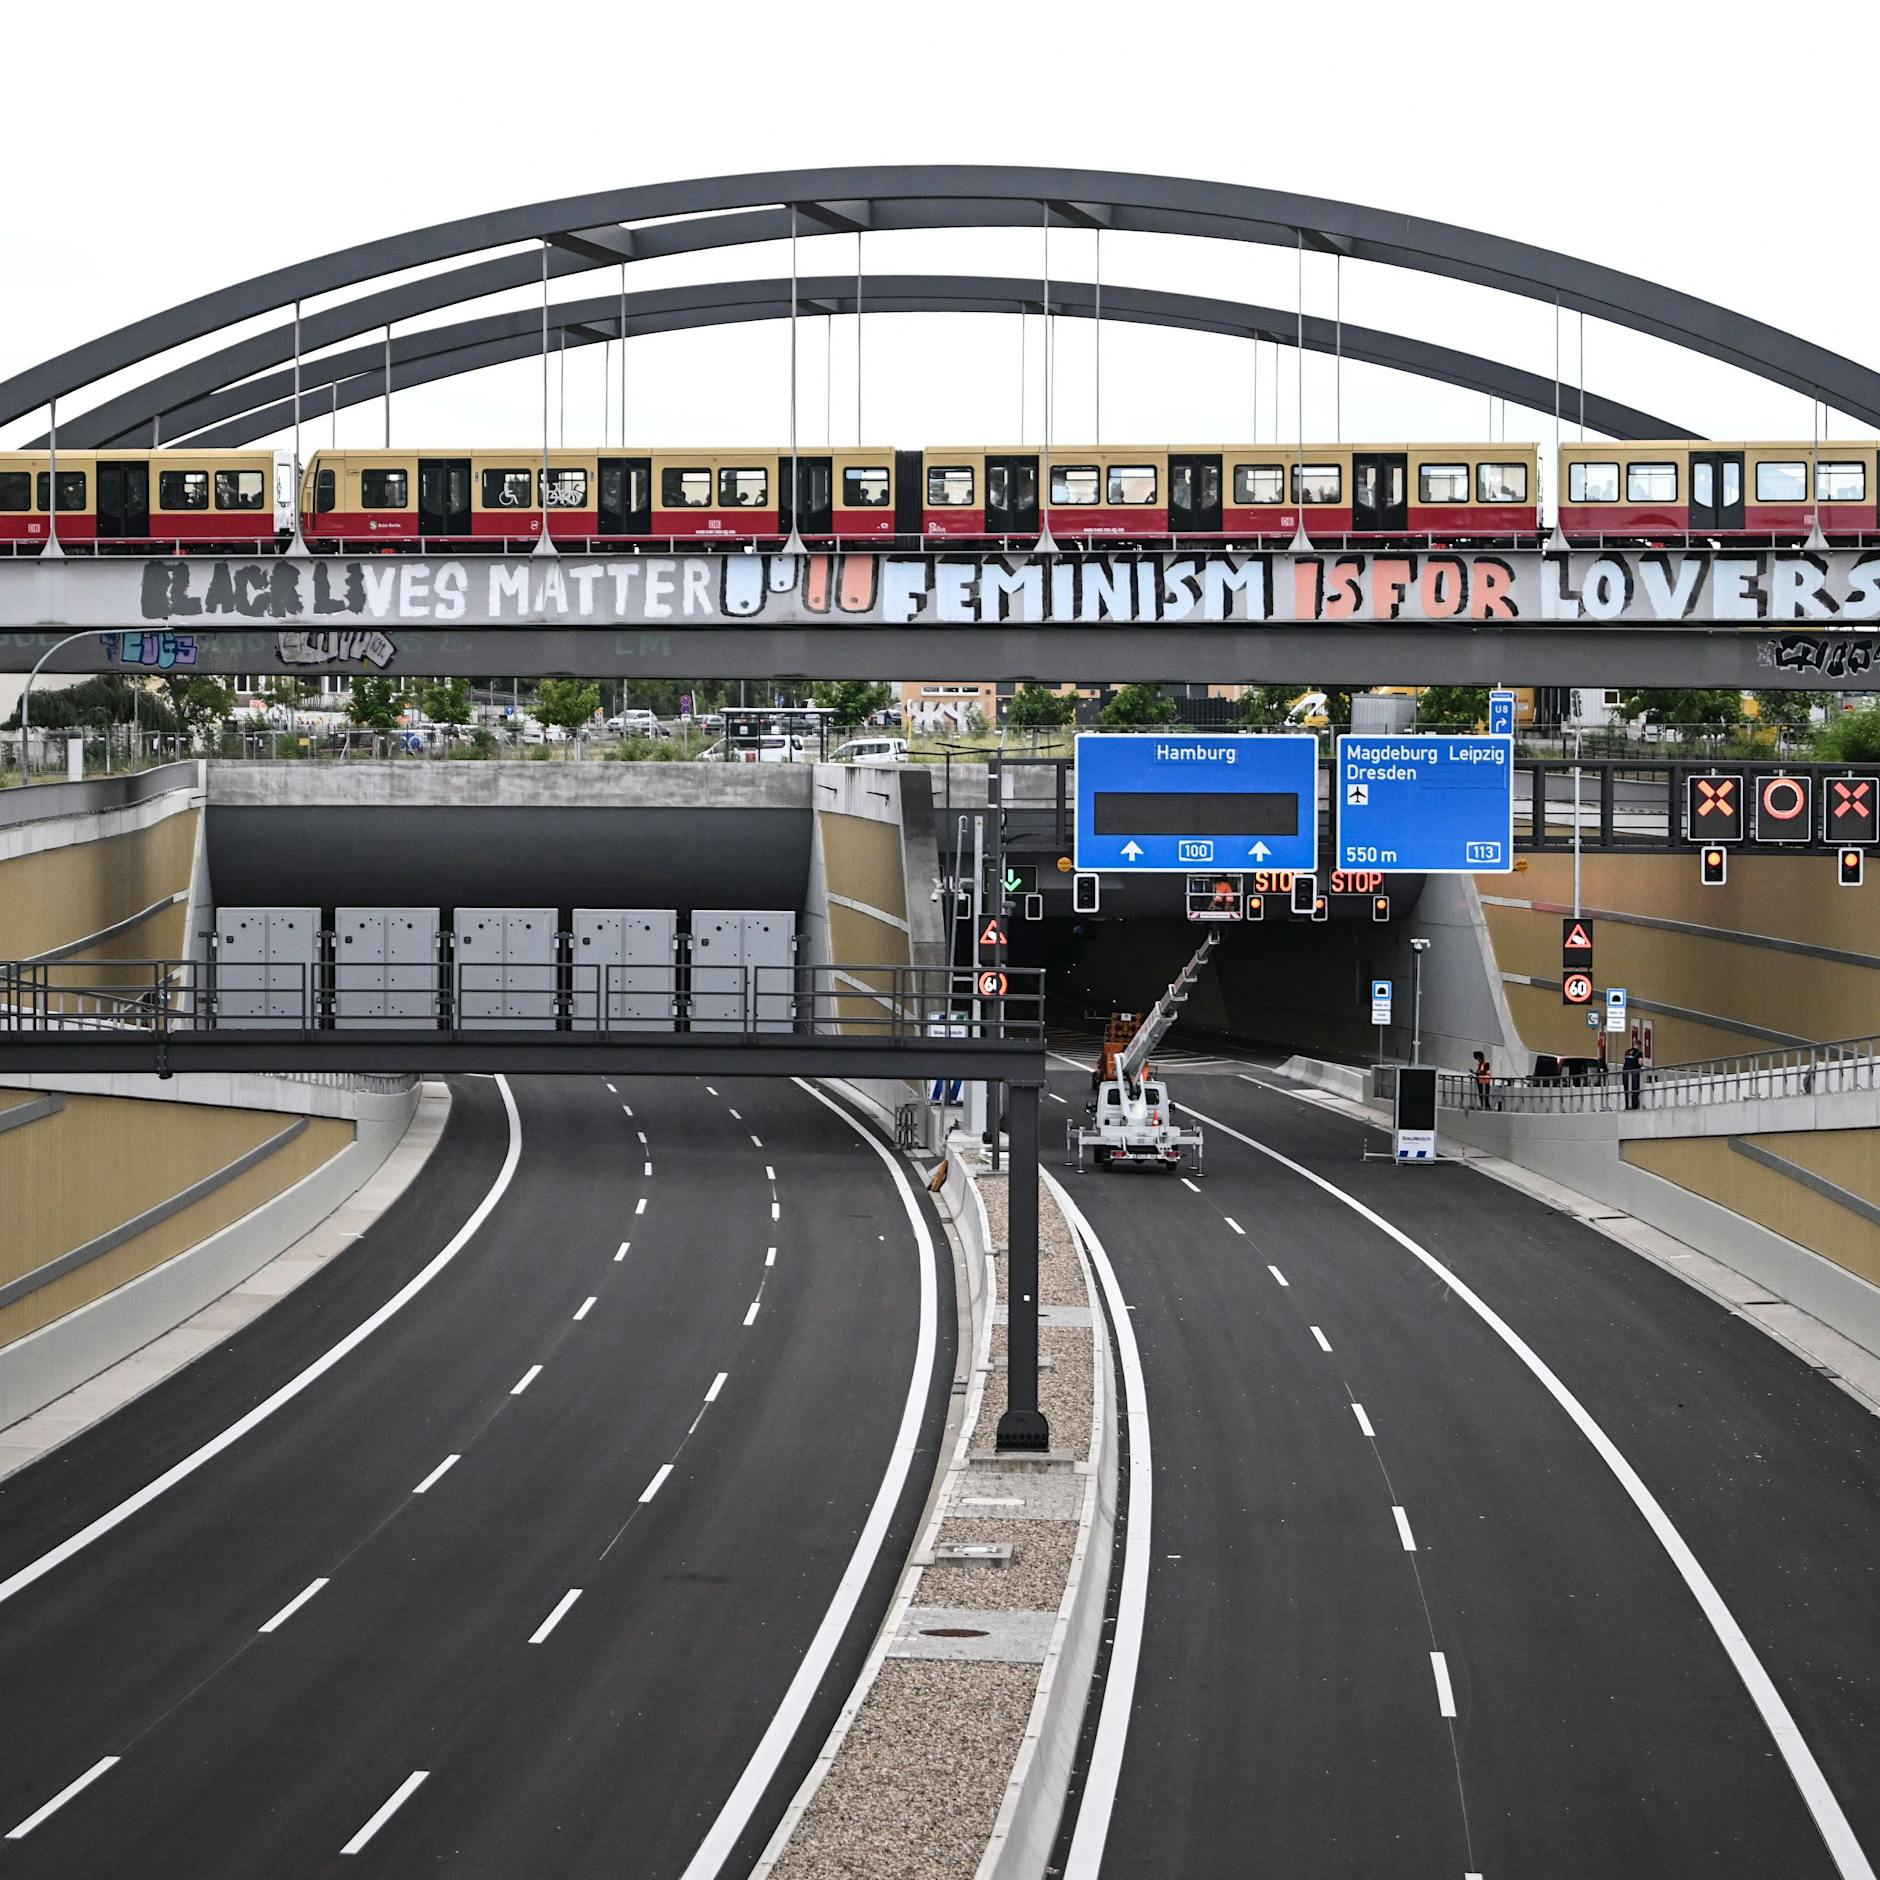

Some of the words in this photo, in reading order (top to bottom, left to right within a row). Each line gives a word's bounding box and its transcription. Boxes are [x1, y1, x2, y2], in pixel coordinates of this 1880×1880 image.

[488, 558, 714, 618] MATTER
[883, 553, 1273, 622] FEMINISM
[1541, 550, 1880, 620] LOVERS
[1156, 744, 1236, 764] Hamburg
[1347, 745, 1438, 764] Magdeburg
[1449, 745, 1505, 764] Leipzig
[1347, 765, 1416, 780] Dresden
[1184, 844, 1207, 857] 100
[1346, 847, 1377, 862] 550
[1381, 850, 1397, 862] m
[1473, 846, 1494, 859] 113
[1255, 872, 1294, 892] STO
[1331, 871, 1383, 892] STOP
[1569, 980, 1587, 997] 60
